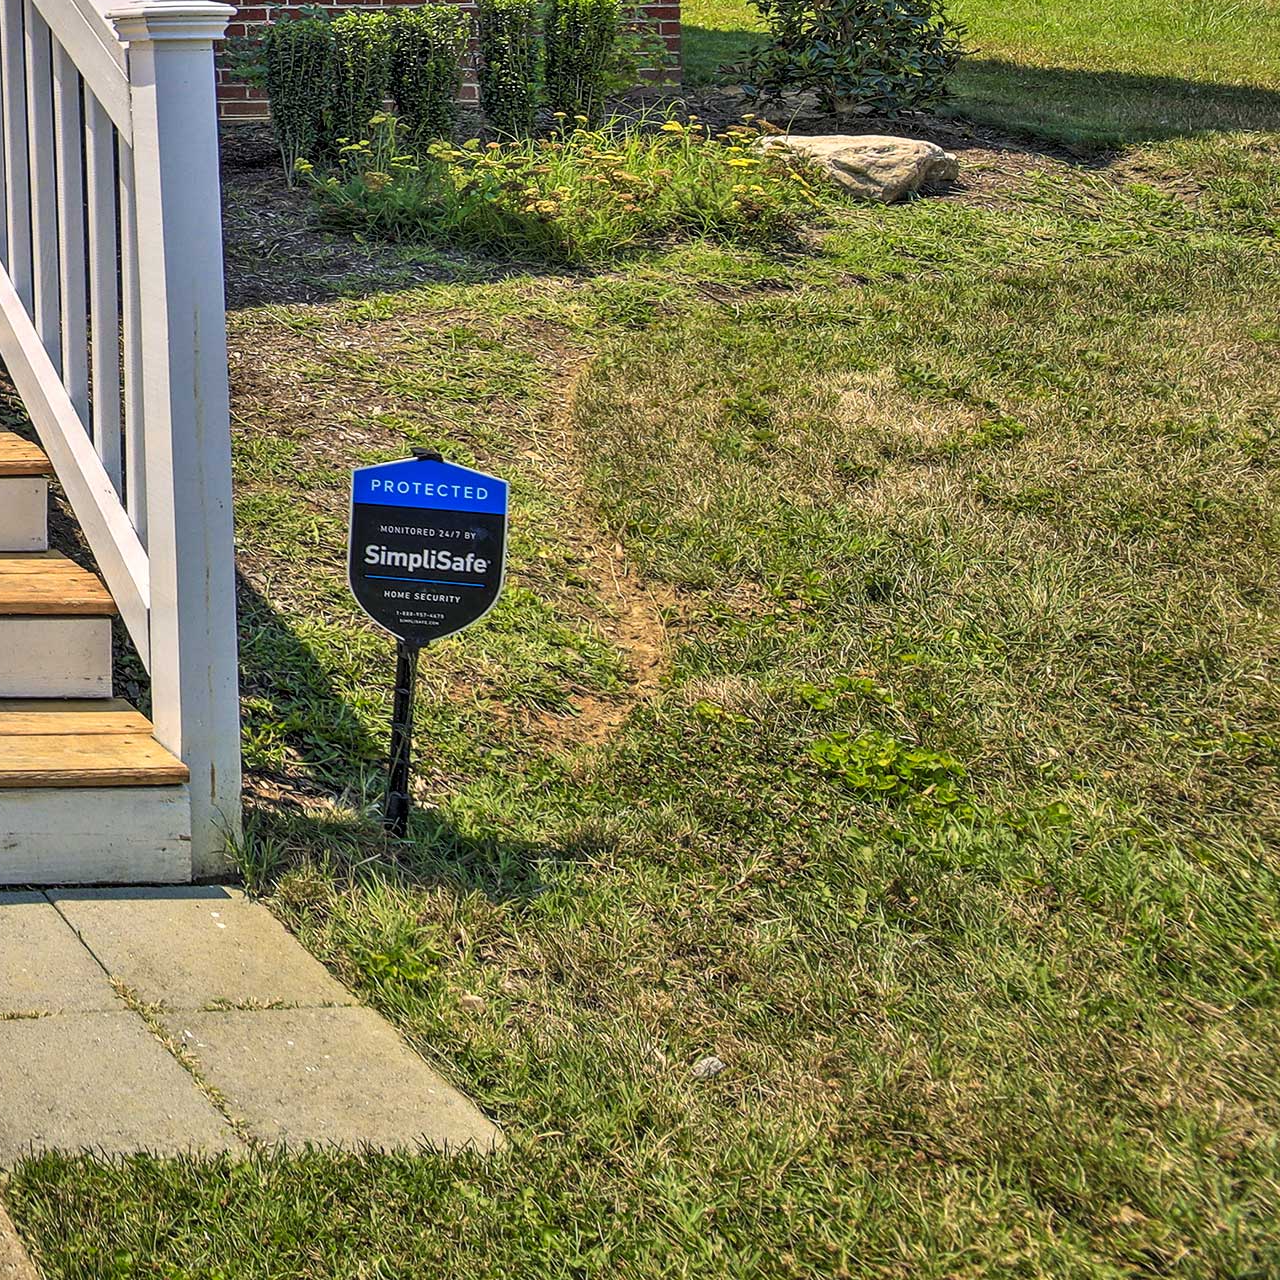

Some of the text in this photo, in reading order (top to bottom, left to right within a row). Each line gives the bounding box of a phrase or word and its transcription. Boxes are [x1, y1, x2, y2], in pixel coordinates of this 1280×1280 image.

[371, 479, 489, 500] PROTECTED
[379, 525, 477, 540] MONITORED 24/7 BY
[364, 545, 489, 574] SimpliSafe
[383, 590, 461, 604] HOME SECURITY
